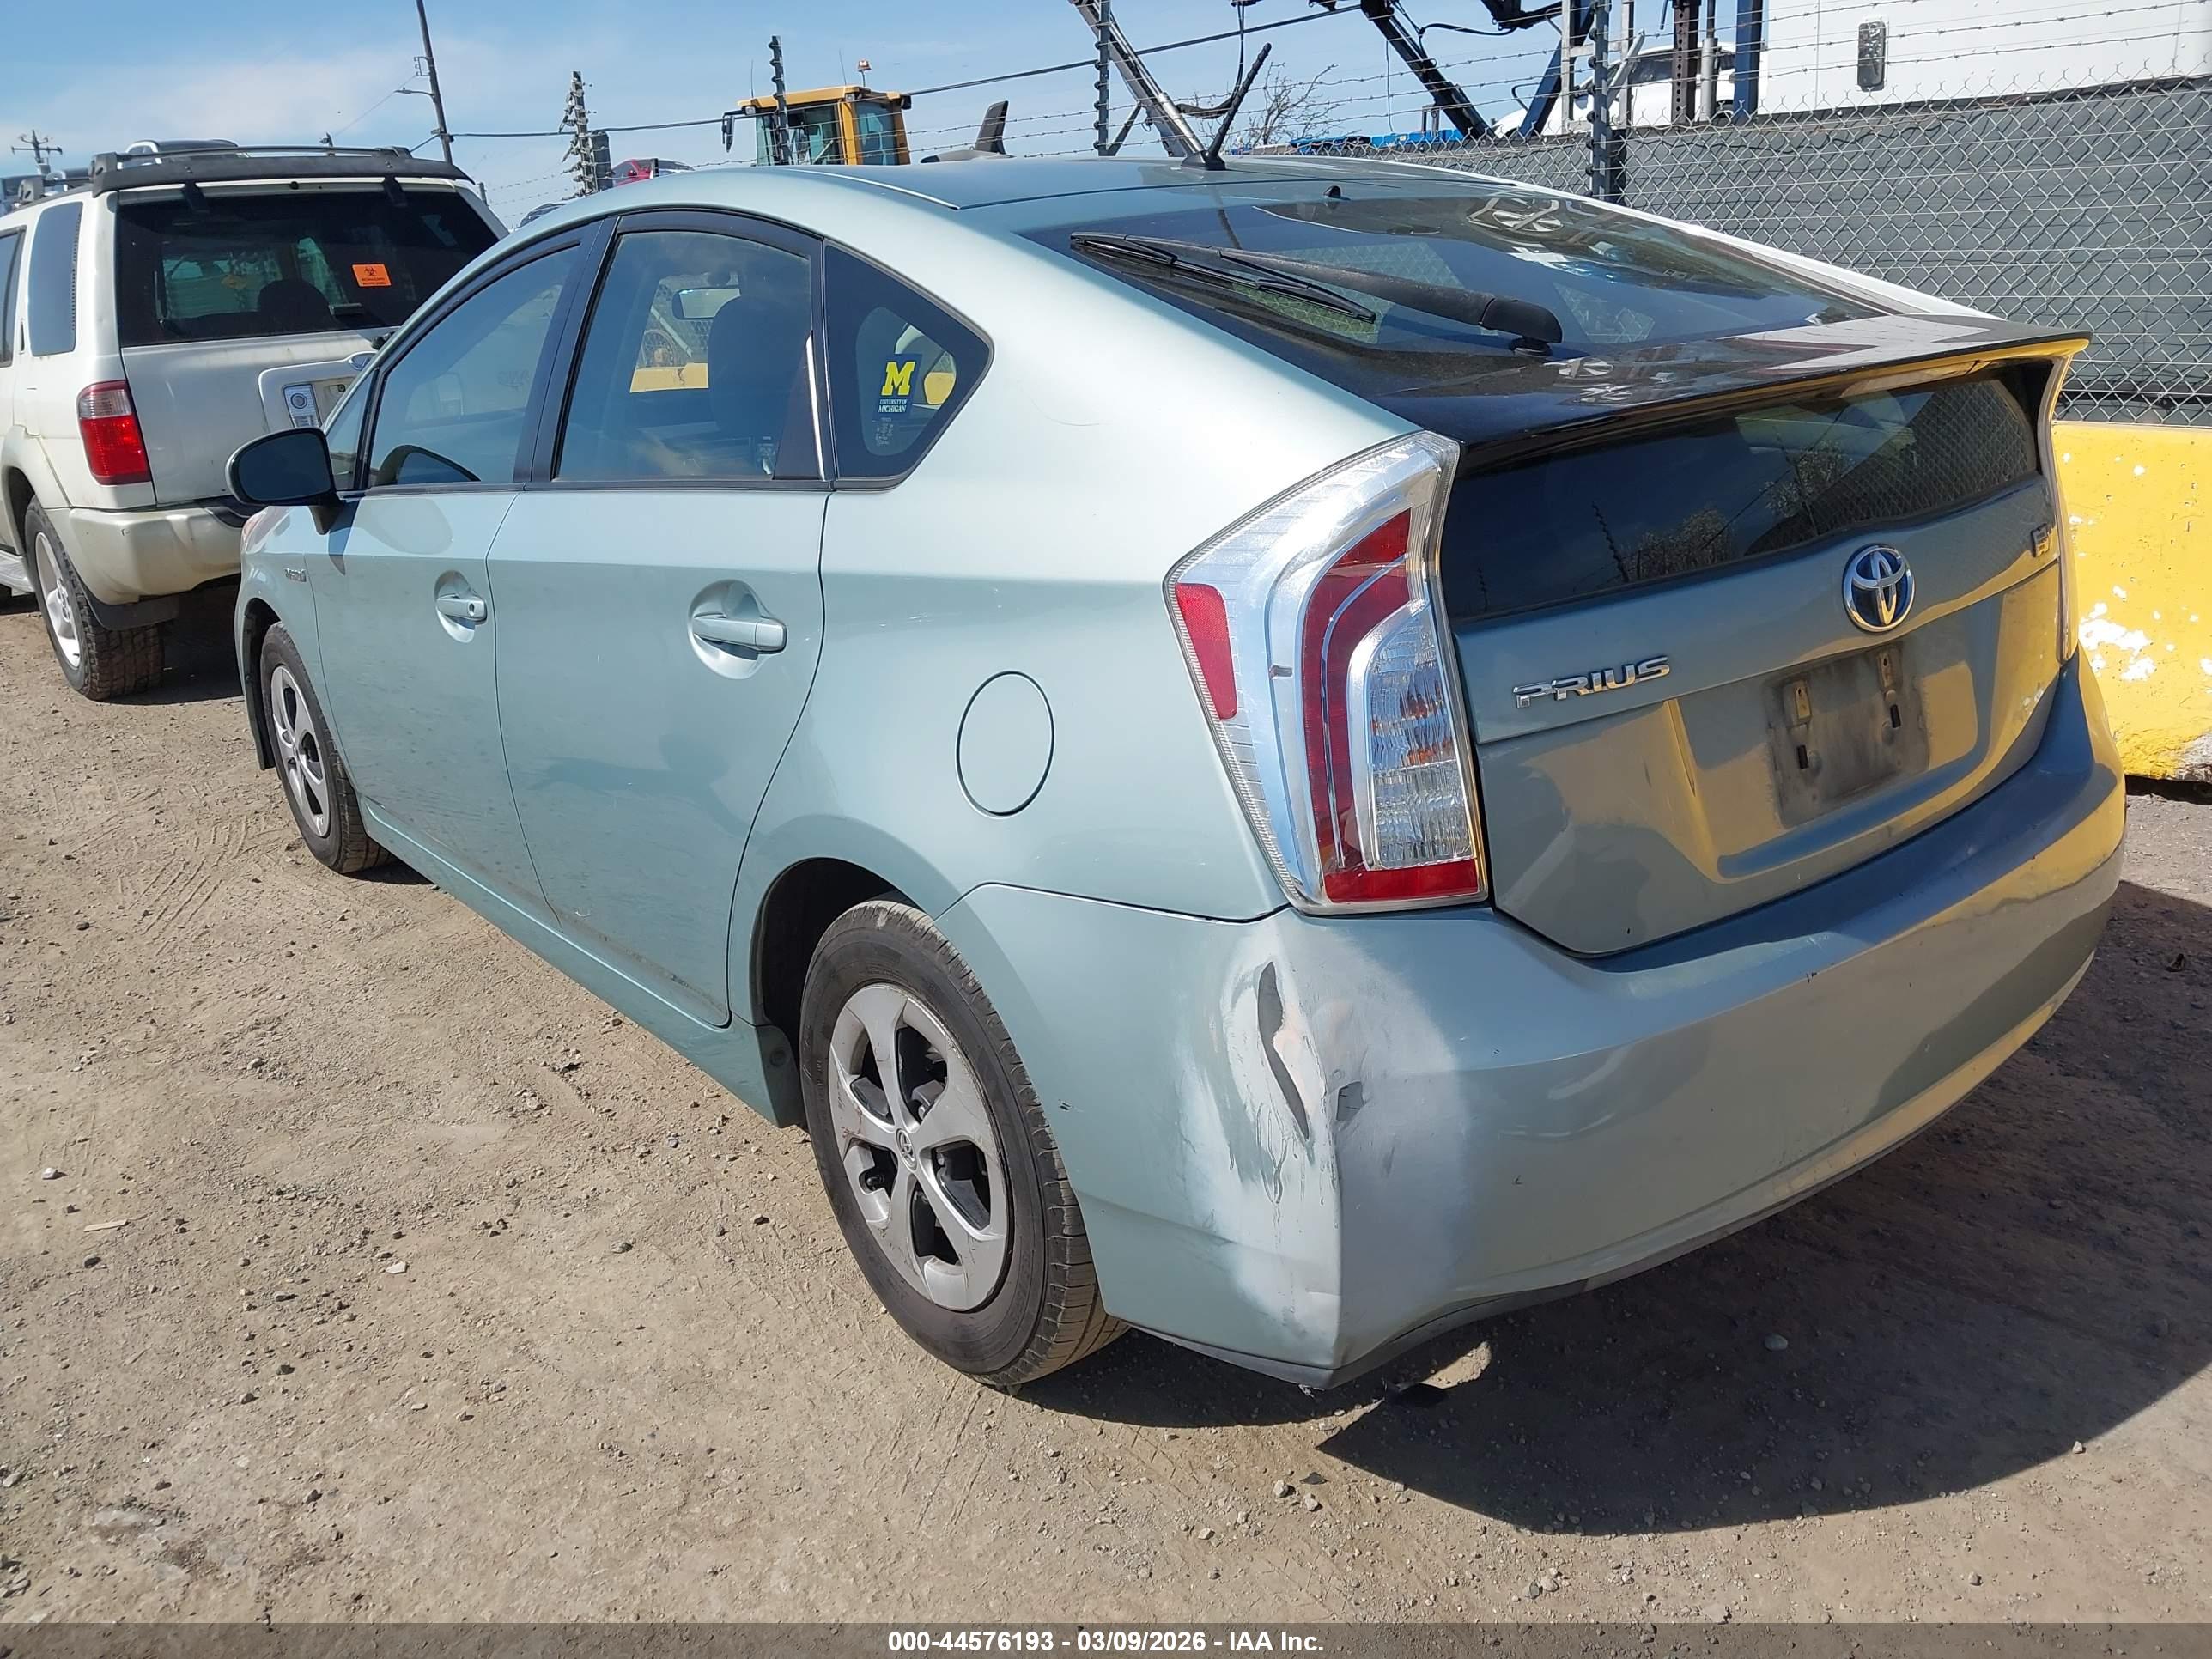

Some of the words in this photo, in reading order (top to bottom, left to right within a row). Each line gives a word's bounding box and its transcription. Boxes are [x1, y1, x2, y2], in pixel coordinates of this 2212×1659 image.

[881, 361, 916, 396] M
[878, 404, 907, 413] MICHIGAN
[1513, 655, 1671, 708] PRIUS
